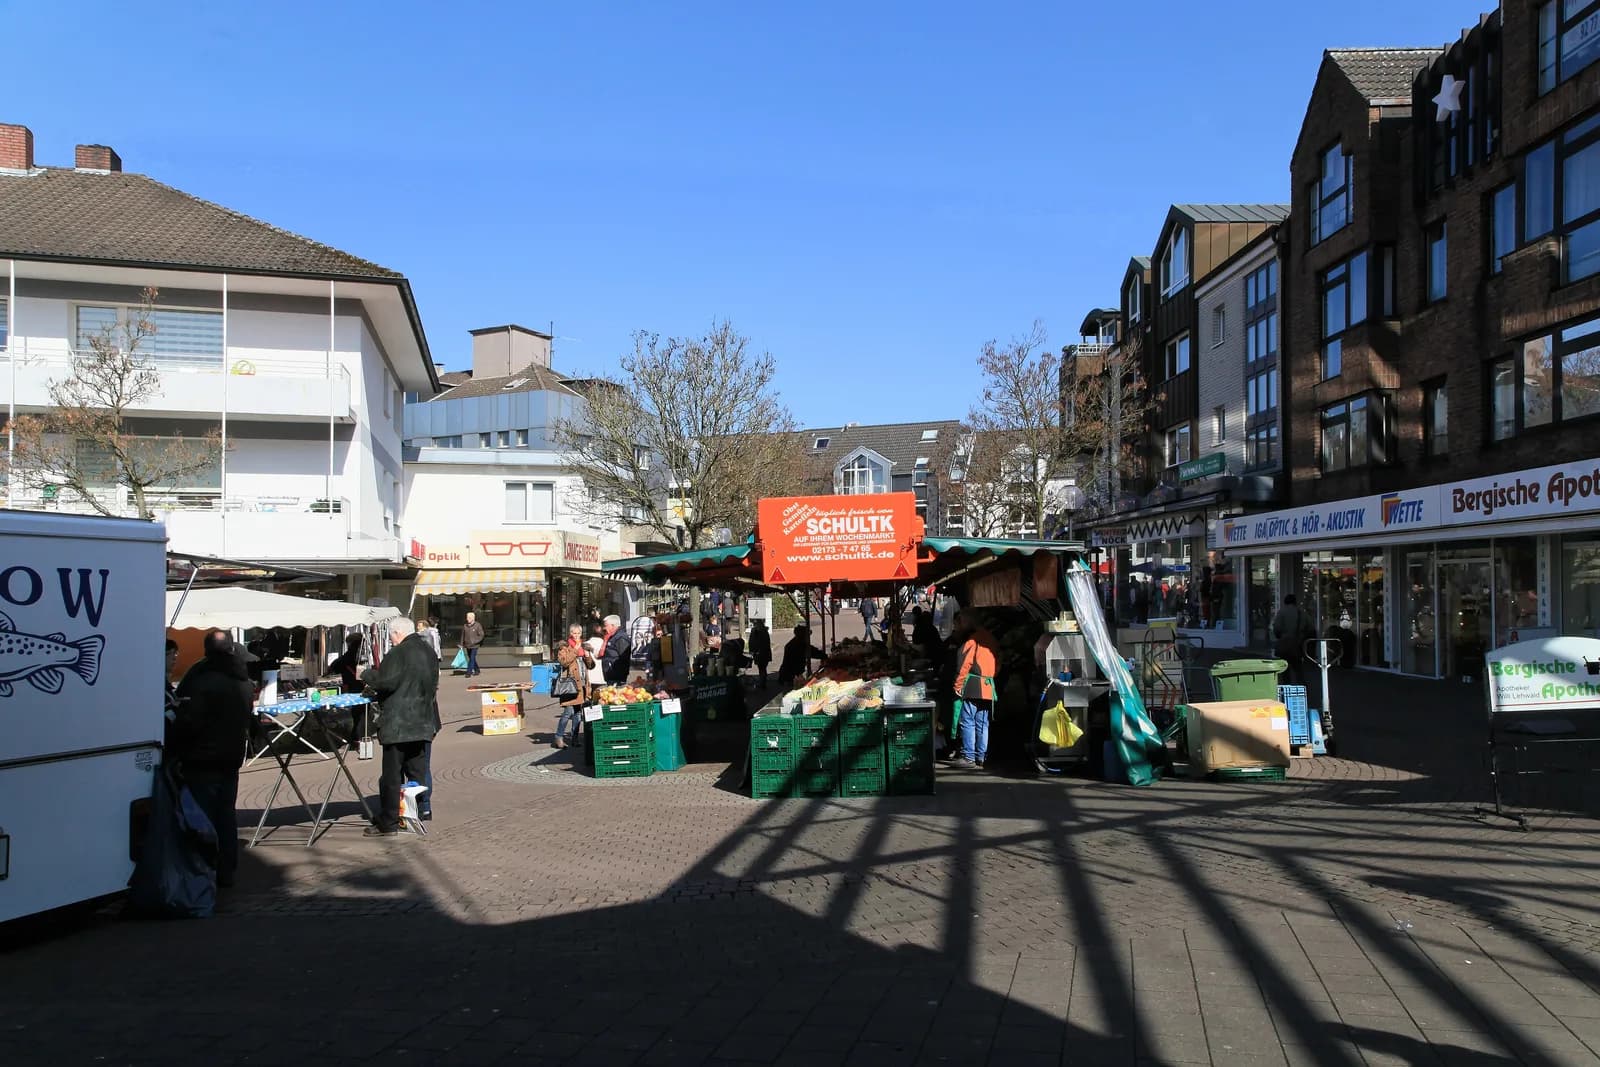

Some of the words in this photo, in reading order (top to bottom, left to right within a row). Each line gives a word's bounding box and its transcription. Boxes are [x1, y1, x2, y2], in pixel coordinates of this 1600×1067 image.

[1452, 478, 1541, 516] Bergische
[782, 502, 800, 517] Obst
[782, 504, 809, 527] Gemüse
[815, 508, 846, 518] täglich
[848, 507, 875, 518] frisch
[783, 506, 818, 536] Kartoffeln
[806, 515, 895, 535] SCHULTK
[1268, 518, 1289, 538] OPTIC
[1292, 520, 1298, 536] &
[1388, 499, 1424, 525] WETTE
[793, 535, 809, 543] AUF
[810, 534, 834, 542] IHREM
[835, 532, 896, 542] WOCHENMARKT
[787, 551, 895, 562] www.schultk.de
[812, 545, 836, 554] 02173
[849, 545, 860, 553] 47
[428, 552, 461, 563] Optik
[1490, 658, 1576, 679] Bergische
[1496, 684, 1530, 693] Apotheker
